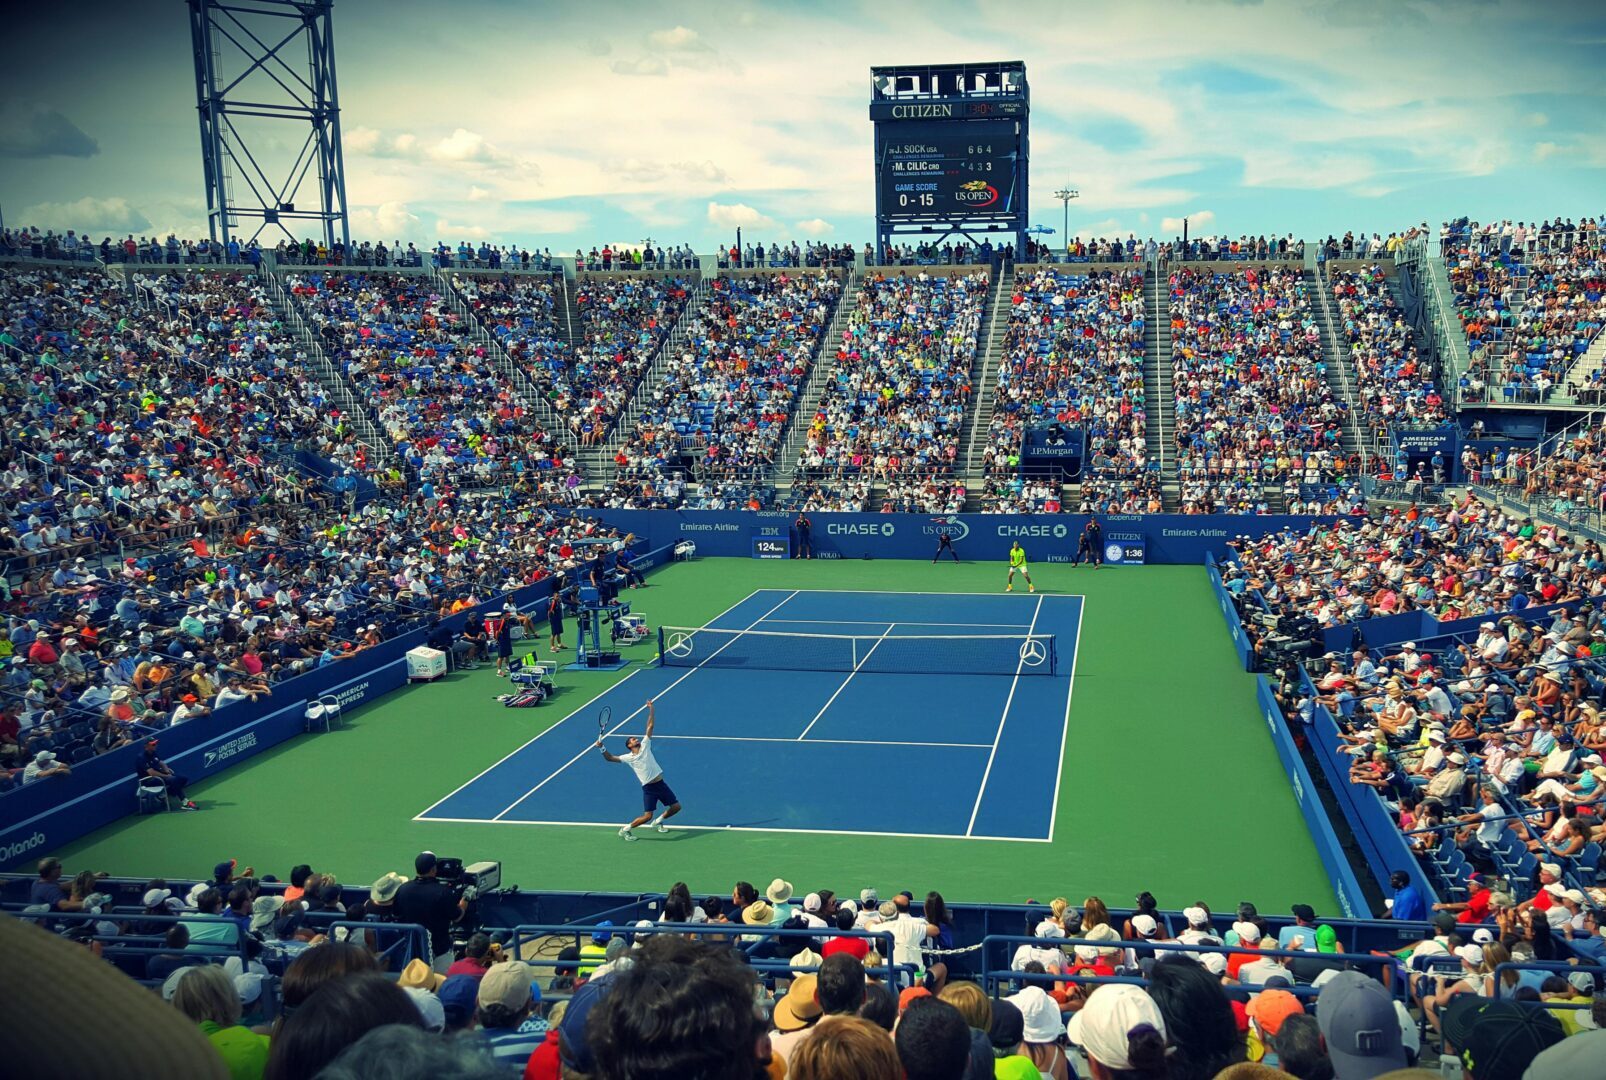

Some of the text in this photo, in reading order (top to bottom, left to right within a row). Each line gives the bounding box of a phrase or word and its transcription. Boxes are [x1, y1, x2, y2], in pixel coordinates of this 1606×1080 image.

[892, 104, 952, 118] CITIZEN
[904, 144, 926, 154] SOCK
[968, 144, 992, 154] 6 6 4
[895, 162, 905, 171] M.
[907, 161, 928, 171] CILIC
[968, 161, 992, 171] 4 3 3
[916, 183, 938, 191] SCORE
[899, 193, 908, 206] 0
[919, 193, 934, 206] 15
[955, 191, 992, 201] US OPEN
[680, 522, 740, 531] Emirates Airline
[760, 527, 780, 536] IBM
[827, 523, 879, 535] CHASE
[922, 525, 963, 535] US OPEN
[997, 525, 1051, 537] CHASE
[1162, 528, 1227, 537] Emirates Airline
[757, 542, 774, 551] 124
[1125, 549, 1143, 557] 1:36
[336, 681, 369, 700] AMERICAN
[218, 731, 255, 754] UNITED STATES
[218, 737, 257, 761] POSTAL SERVICE
[0, 831, 46, 862] Orlando
